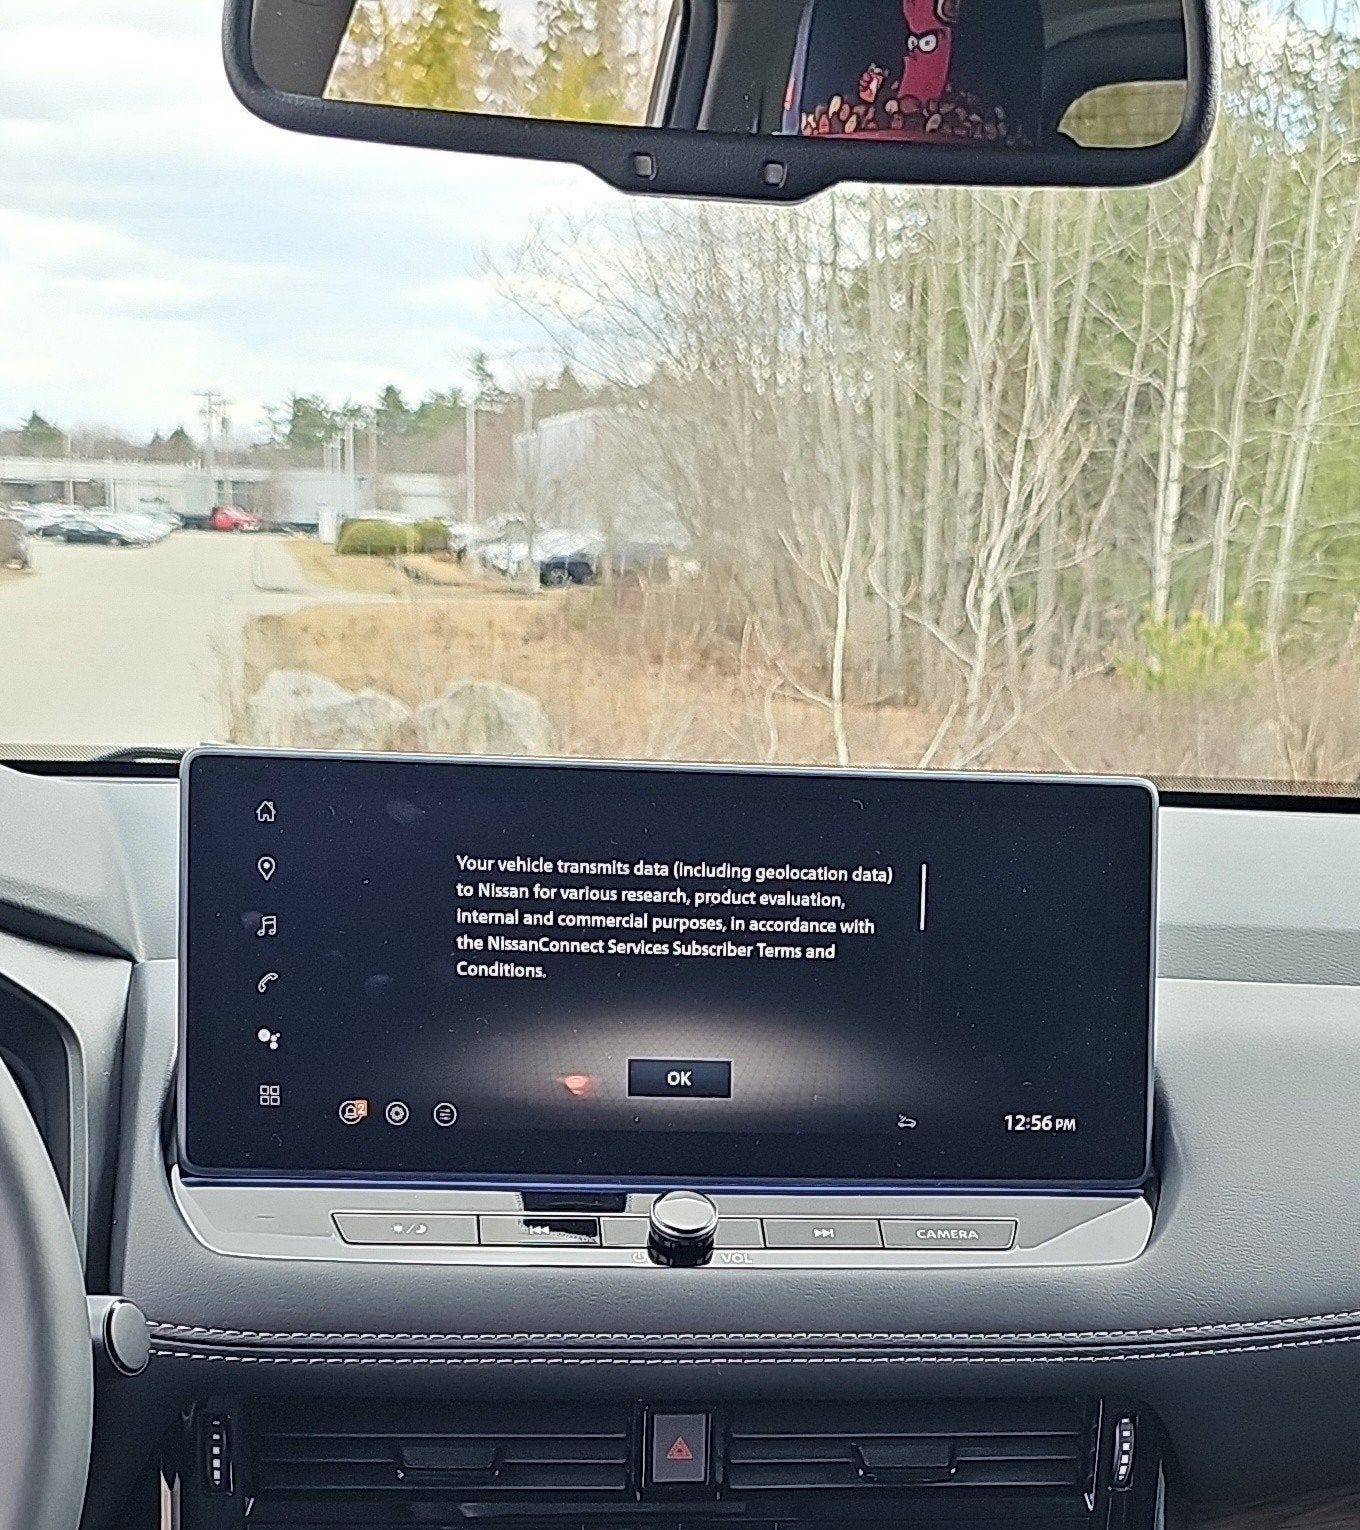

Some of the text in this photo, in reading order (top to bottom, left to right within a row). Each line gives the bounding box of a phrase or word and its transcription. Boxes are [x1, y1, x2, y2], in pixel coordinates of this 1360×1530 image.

[456, 855, 893, 885] Your vehicle transmits data (including geolocation data)
[456, 883, 846, 909] to Nissan for various research, product evaluation,
[456, 908, 875, 934] internal and commercial purposes, in accordance with
[456, 935, 835, 959] the NissanConnect Services Subscriber Terms and
[456, 961, 547, 978] Conditions.
[667, 1071, 692, 1087] OK
[1004, 1114, 1076, 1131] 12:56 PM
[916, 1229, 979, 1240] CAMERA
[720, 1252, 753, 1265] VOL
